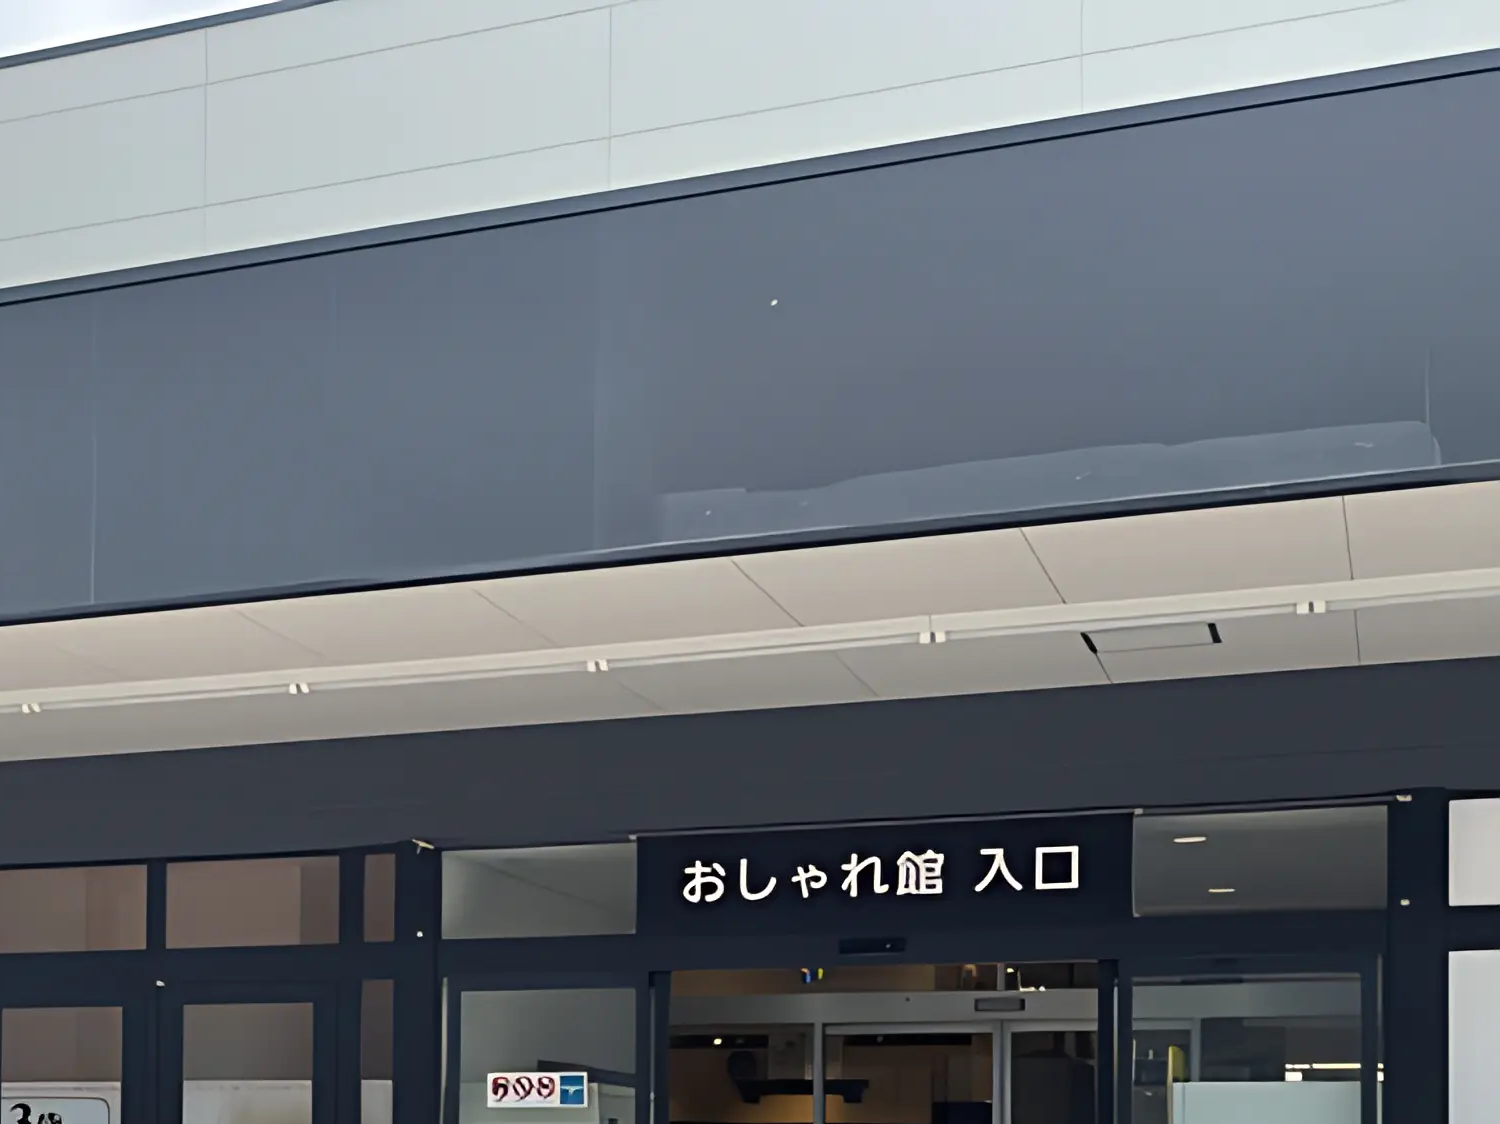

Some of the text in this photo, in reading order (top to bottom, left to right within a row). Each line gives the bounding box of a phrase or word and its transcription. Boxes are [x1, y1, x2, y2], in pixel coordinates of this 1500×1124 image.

[682, 845, 1080, 904] おしゃれ館 入口
